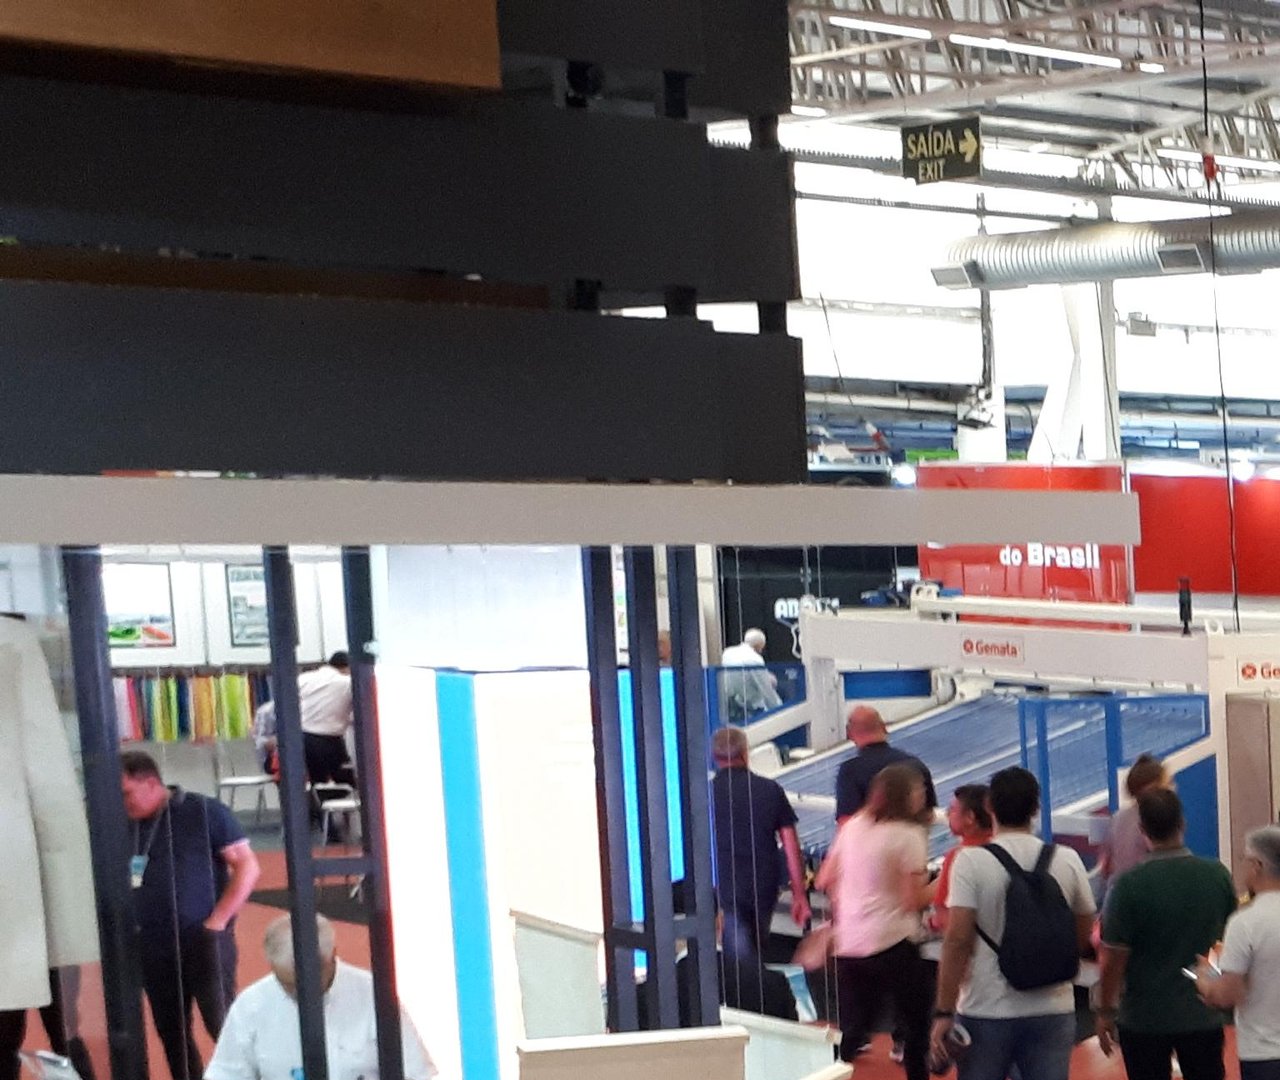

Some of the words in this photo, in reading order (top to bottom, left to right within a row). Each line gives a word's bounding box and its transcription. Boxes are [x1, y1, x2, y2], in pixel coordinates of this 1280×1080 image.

[907, 123, 955, 160] SAÍDA
[918, 159, 946, 182] EXIT
[1000, 545, 1023, 567] do
[1027, 542, 1100, 569] Brasil
[976, 640, 1018, 658] Gemata
